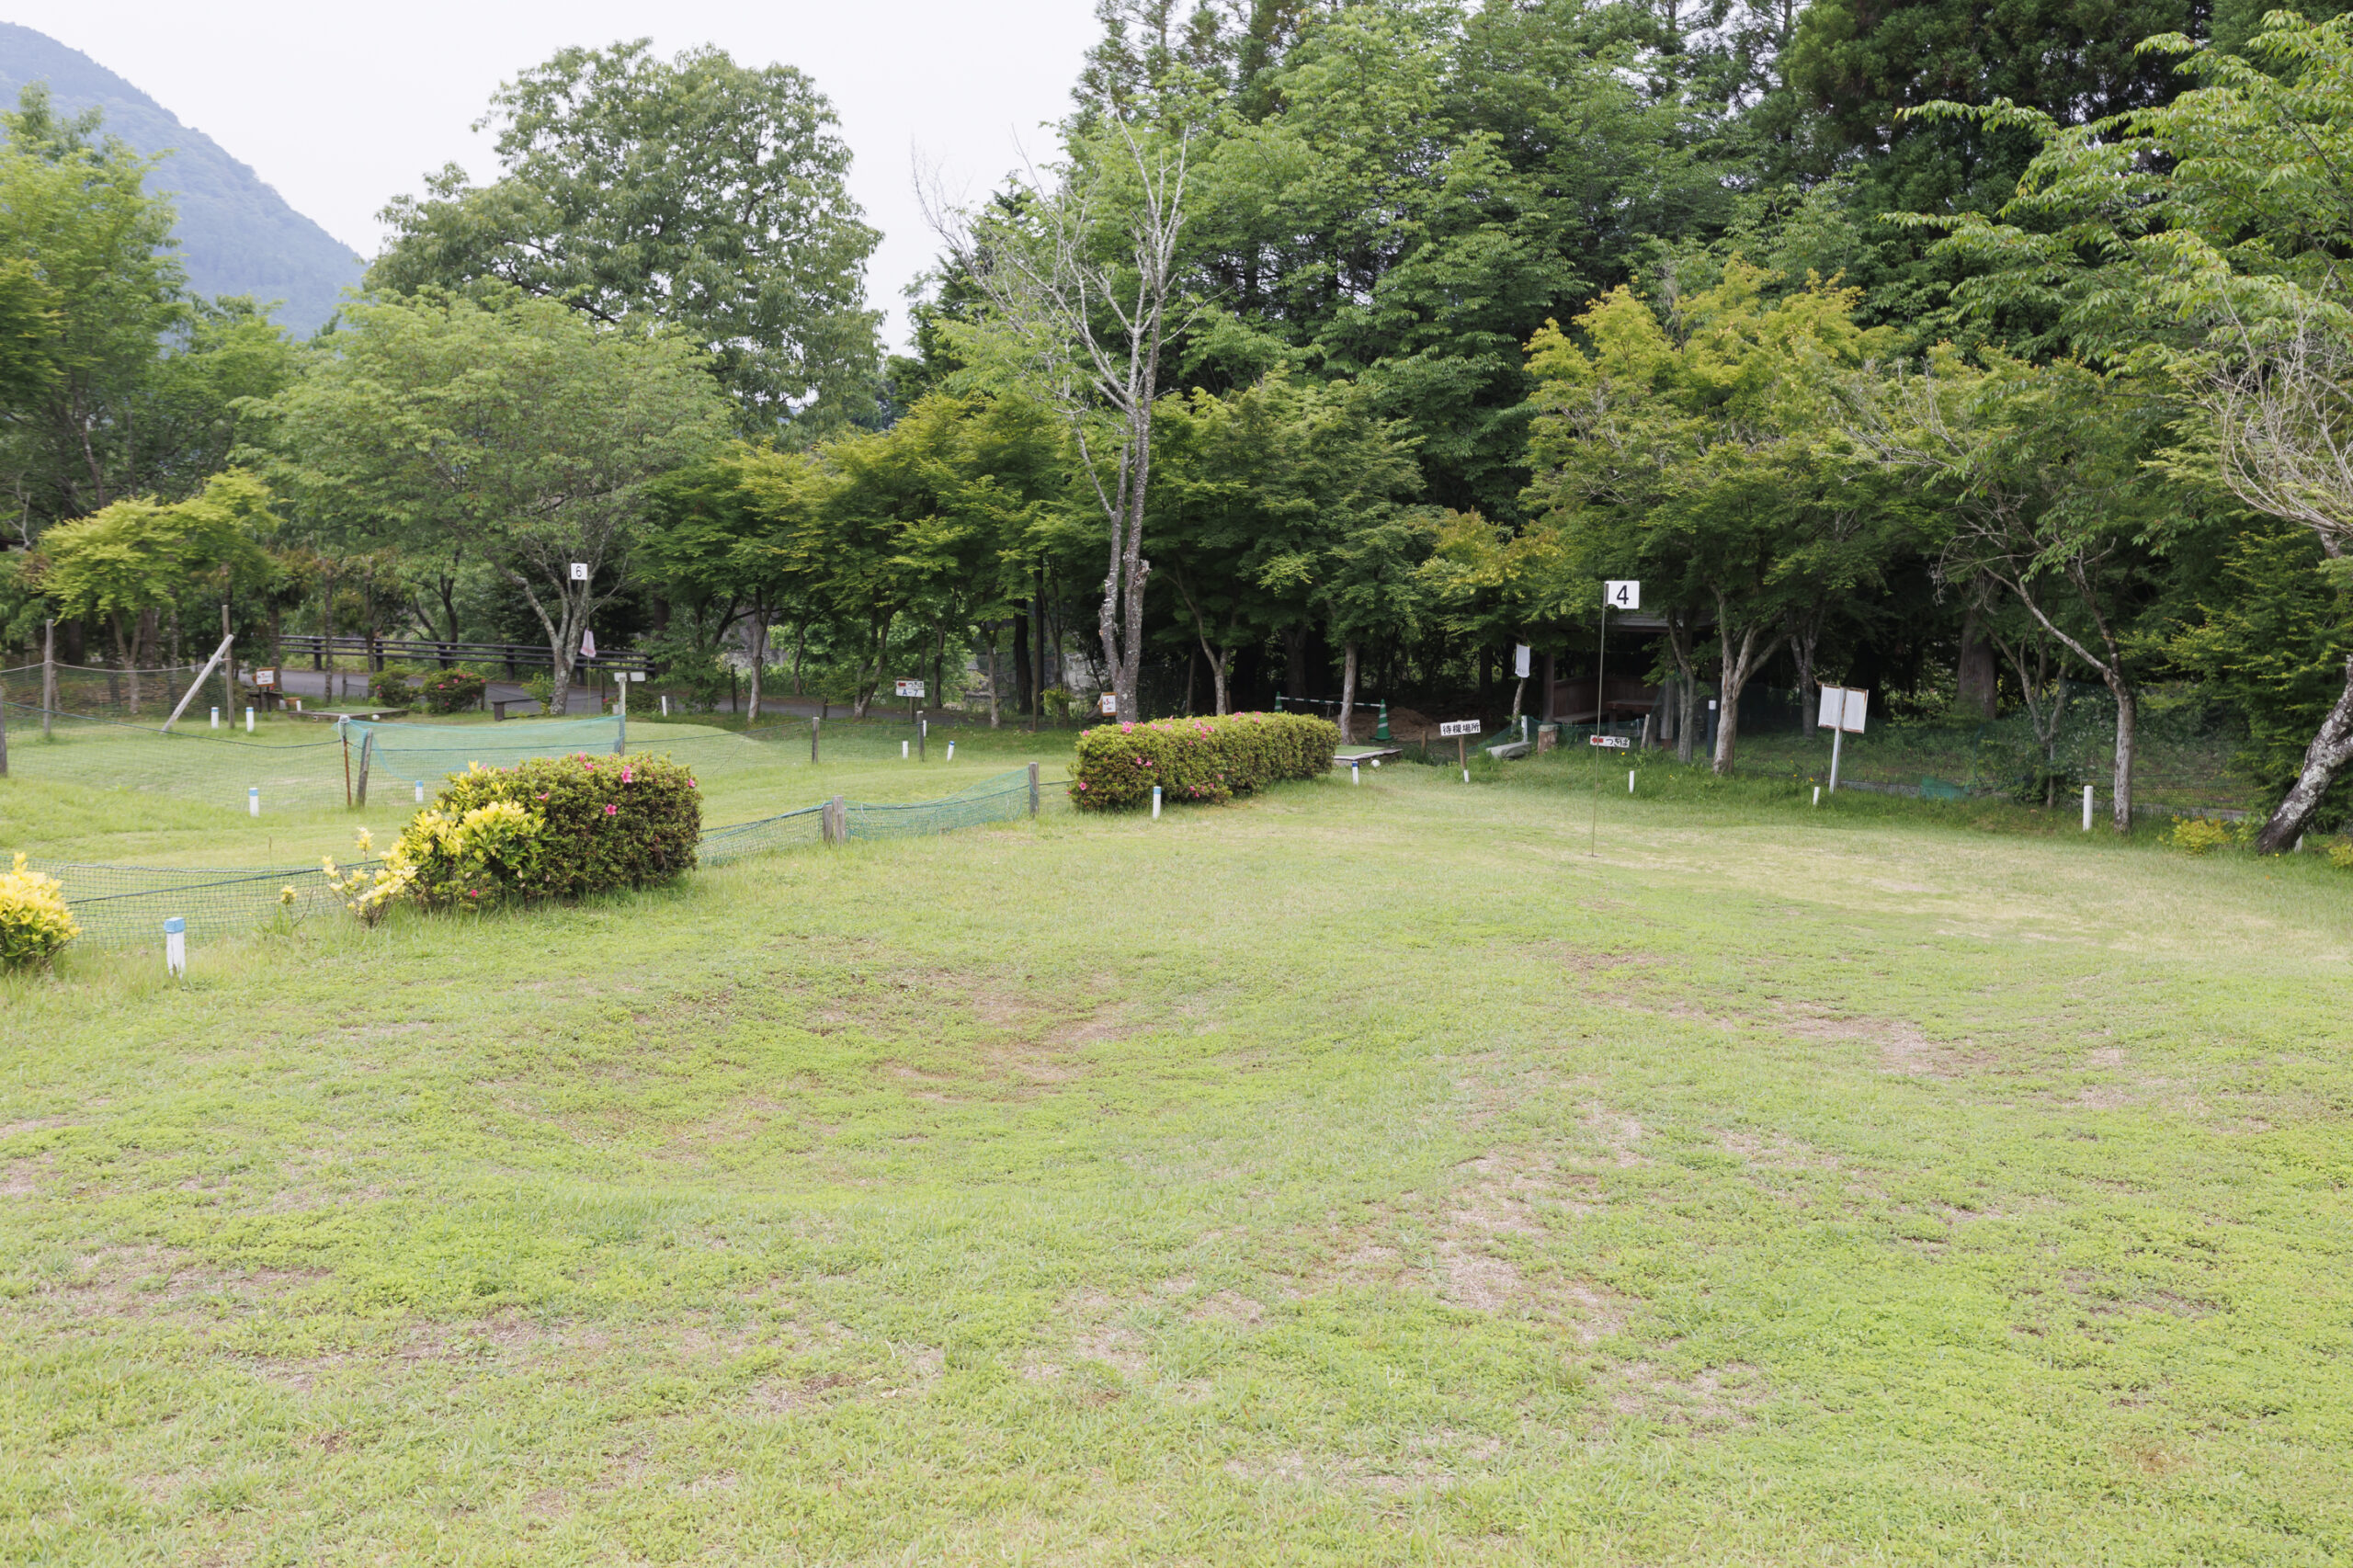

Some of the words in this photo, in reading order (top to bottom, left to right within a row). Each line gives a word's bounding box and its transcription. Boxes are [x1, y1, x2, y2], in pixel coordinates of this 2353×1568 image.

[576, 565, 582, 577] 6
[1617, 585, 1629, 605] 4
[1442, 722, 1480, 734] 待機場所
[1606, 737, 1628, 747] つぎは
